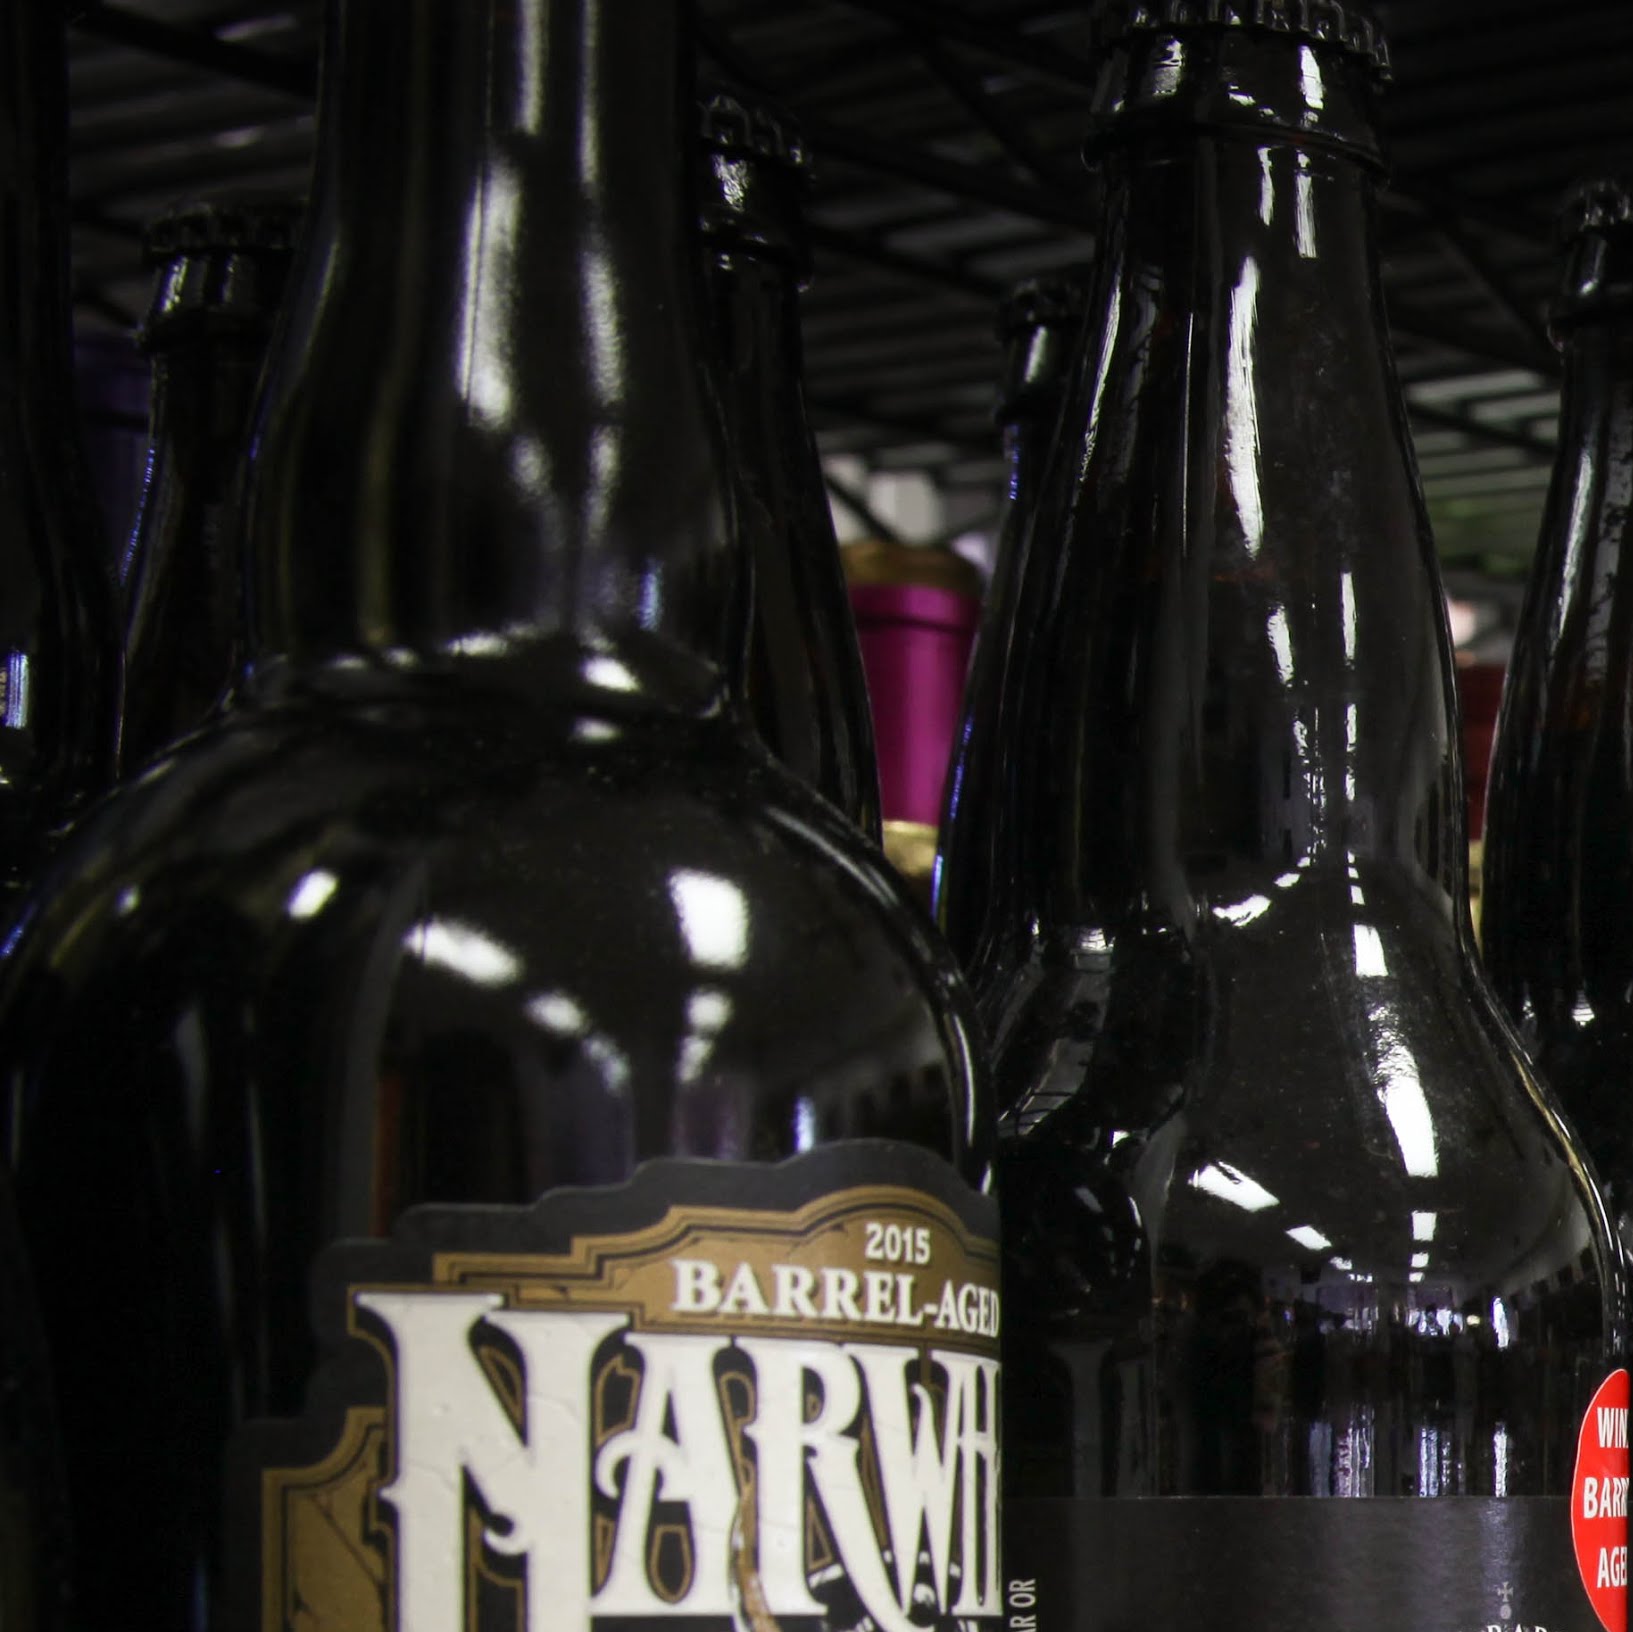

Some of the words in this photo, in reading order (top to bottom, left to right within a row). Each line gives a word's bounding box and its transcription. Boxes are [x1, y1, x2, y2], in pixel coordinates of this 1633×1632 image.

[865, 1224, 932, 1262] 2015
[671, 1257, 1000, 1339] BARREL-AGED
[1008, 1577, 1038, 1608] OR
